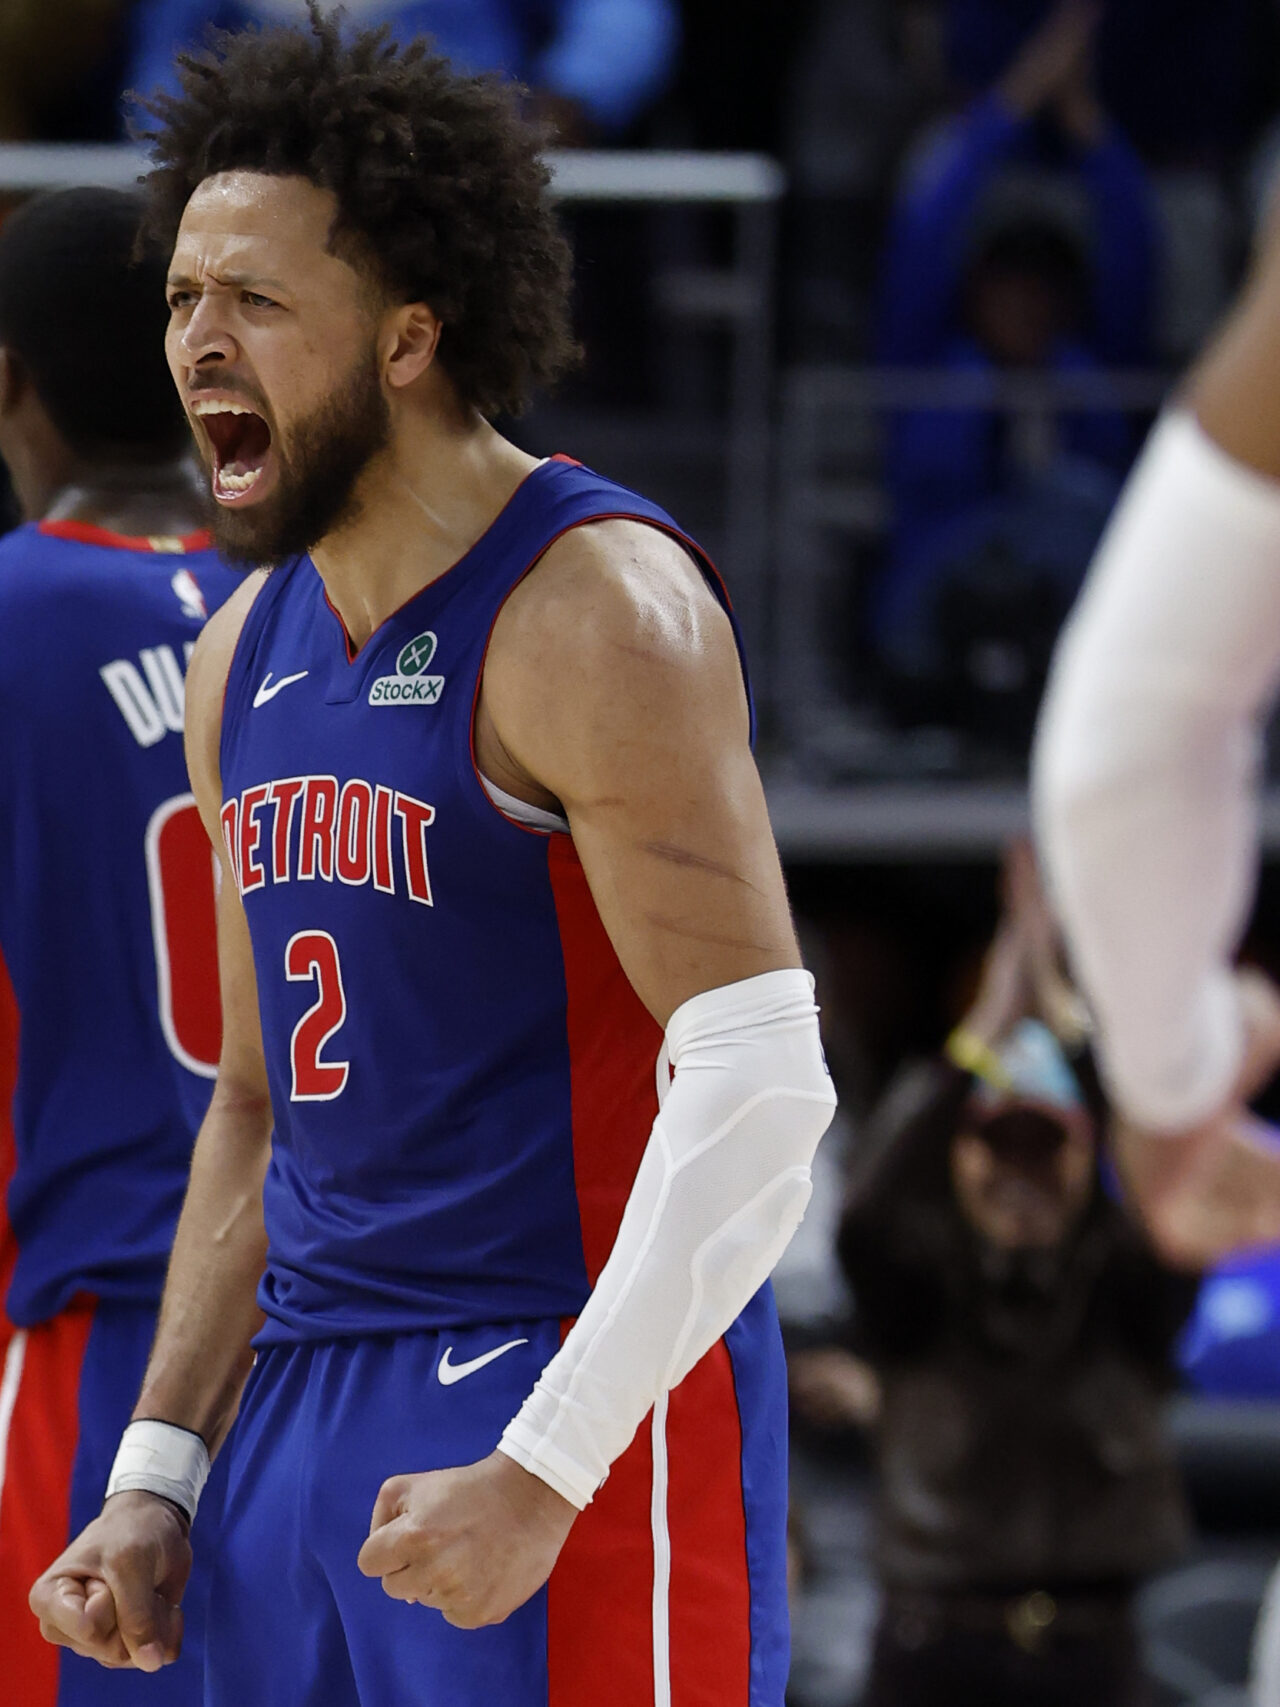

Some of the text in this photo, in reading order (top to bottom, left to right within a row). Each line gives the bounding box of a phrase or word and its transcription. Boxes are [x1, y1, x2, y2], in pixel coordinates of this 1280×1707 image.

[98, 640, 196, 749] DU
[372, 679, 442, 700] StockX
[284, 929, 350, 1102] 2
